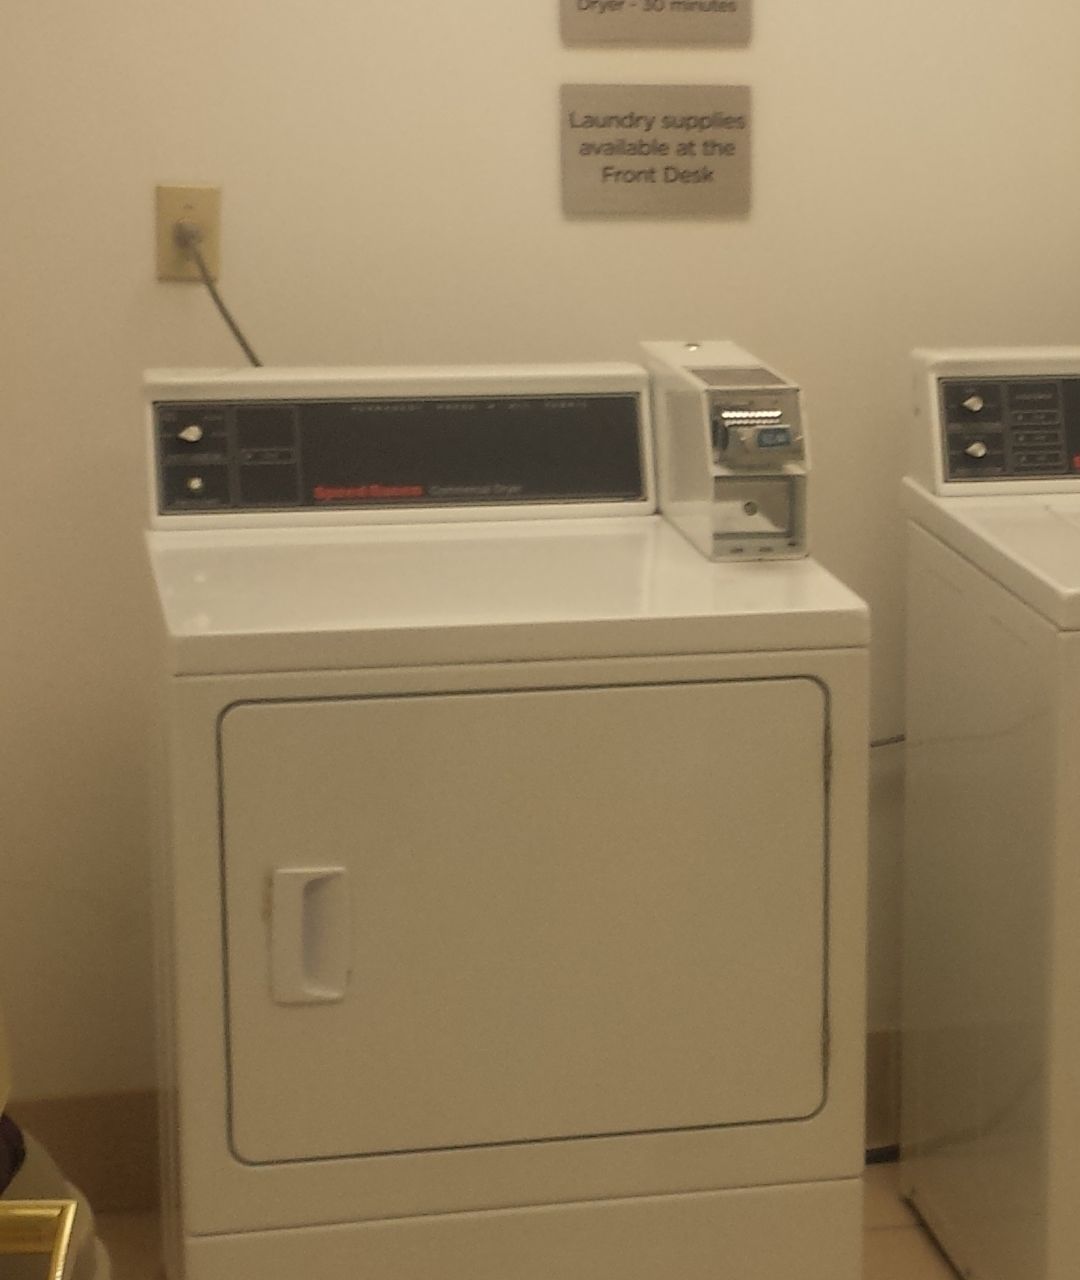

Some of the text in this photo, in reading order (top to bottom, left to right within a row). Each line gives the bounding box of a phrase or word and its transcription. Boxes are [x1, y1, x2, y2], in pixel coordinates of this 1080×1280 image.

[568, 111, 746, 132] Laundry supplies
[578, 139, 736, 157] available at the
[602, 166, 714, 184] Front Desk
